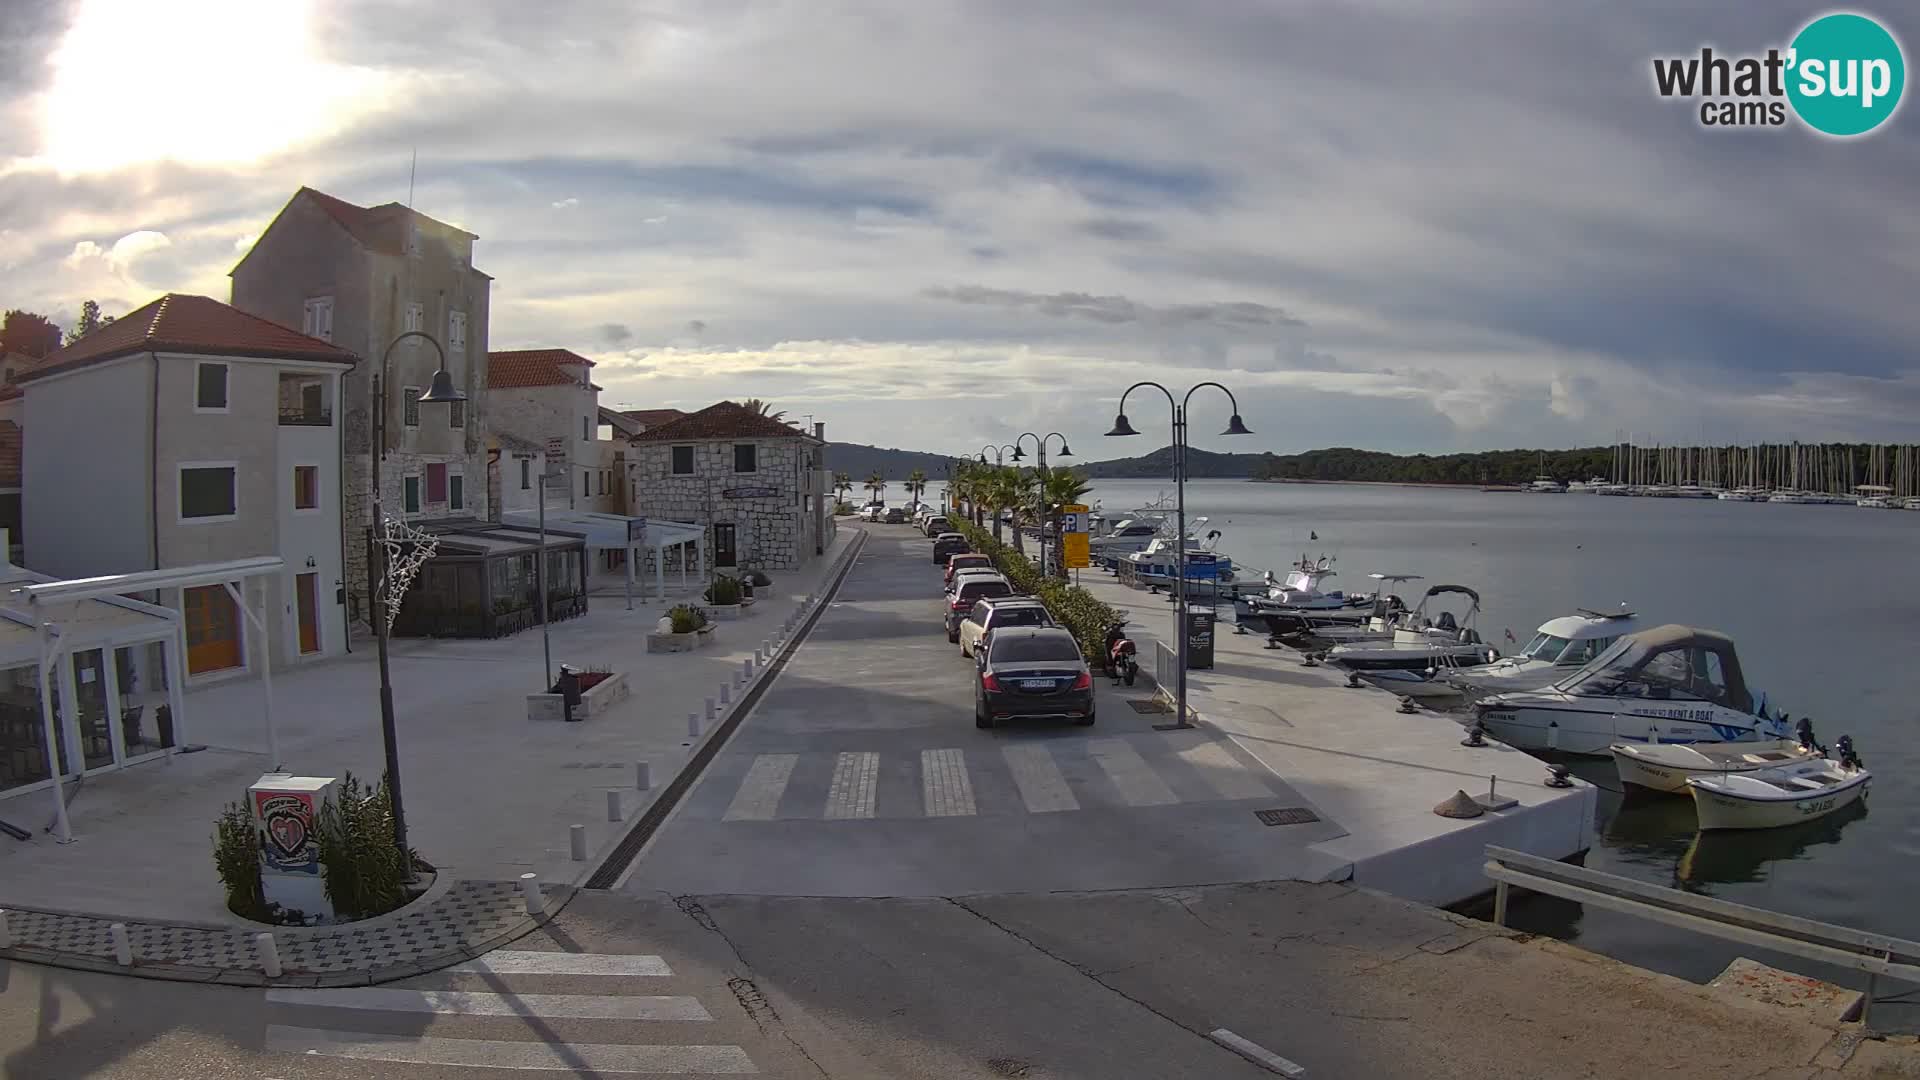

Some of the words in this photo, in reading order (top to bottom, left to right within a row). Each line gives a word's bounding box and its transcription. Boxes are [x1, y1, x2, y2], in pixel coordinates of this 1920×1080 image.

[1066, 515, 1076, 530] P
[1668, 708, 1688, 719] RENT
[1689, 709, 1694, 719] A
[1695, 710, 1714, 722] BOAT
